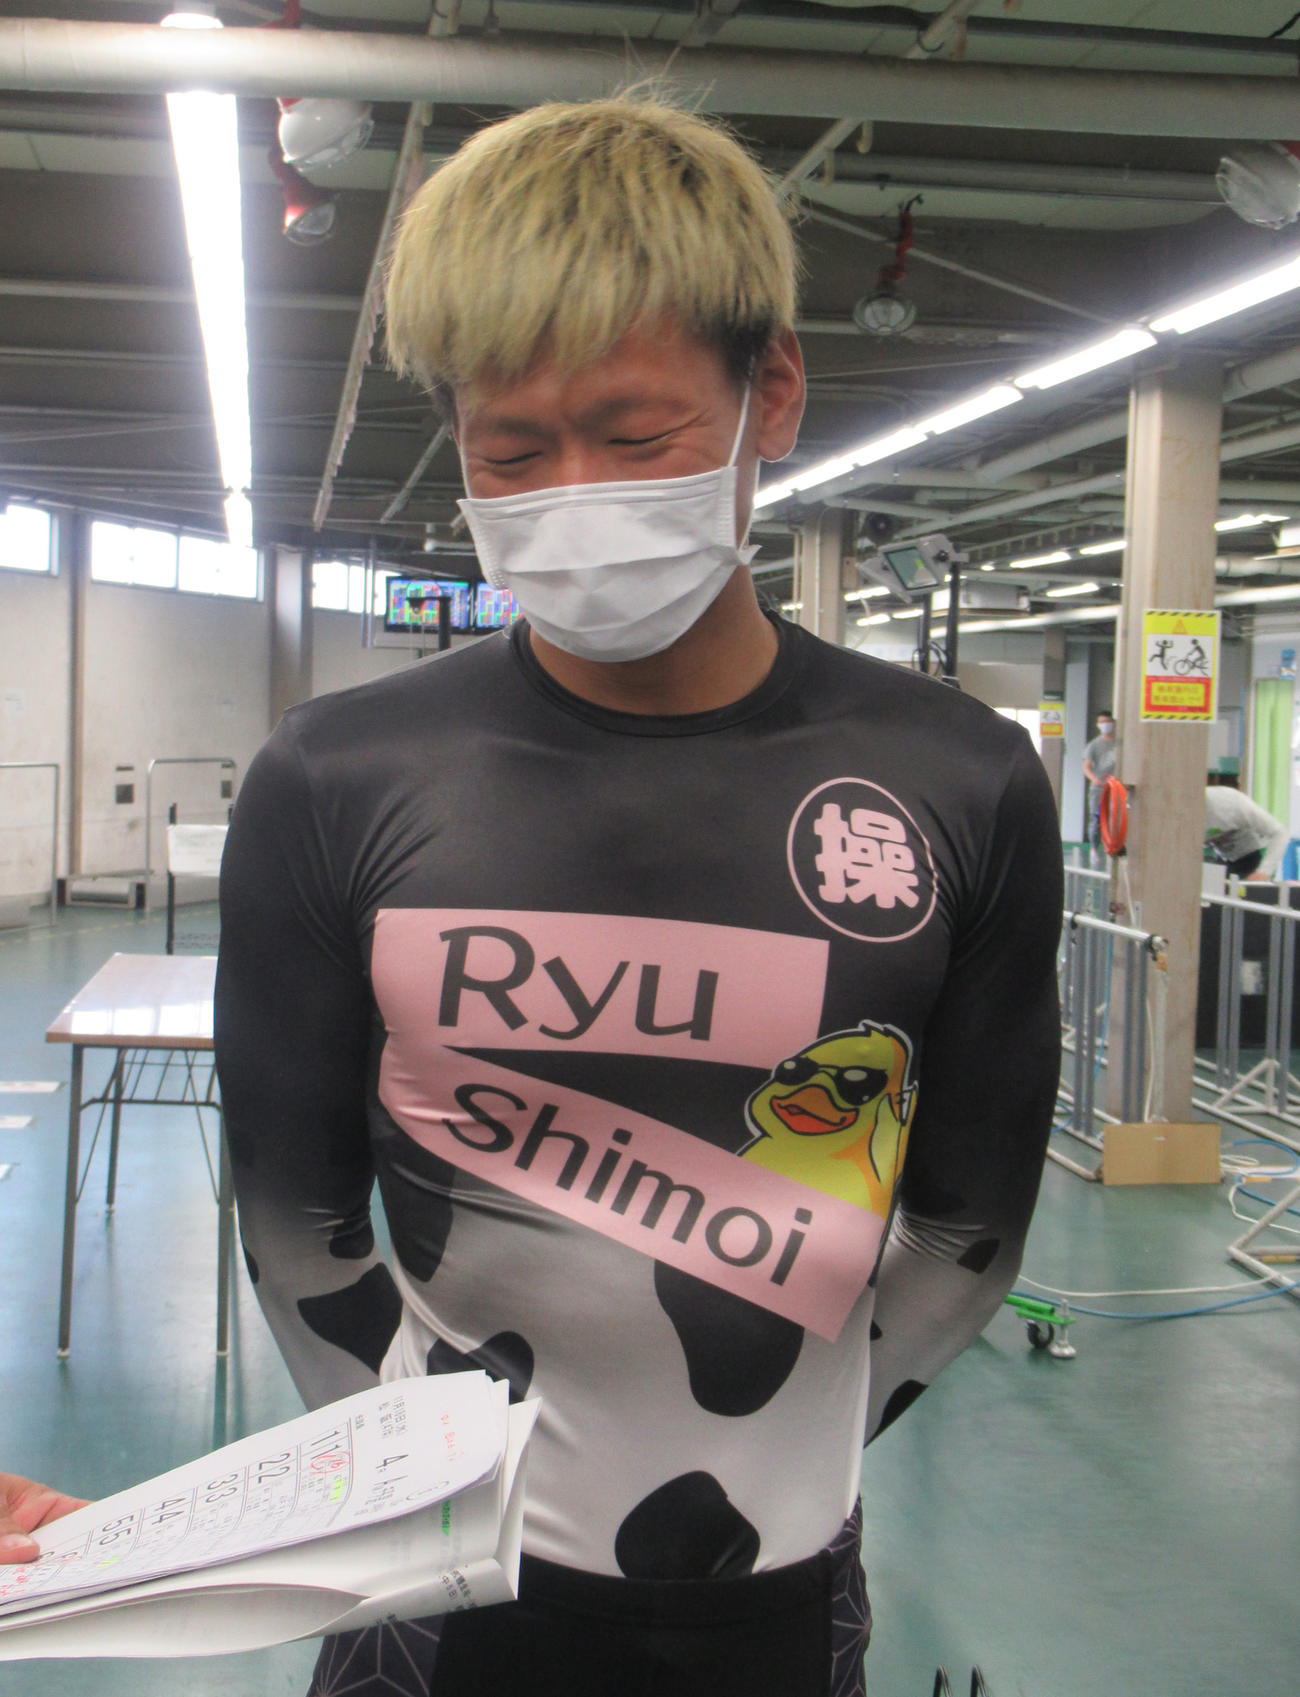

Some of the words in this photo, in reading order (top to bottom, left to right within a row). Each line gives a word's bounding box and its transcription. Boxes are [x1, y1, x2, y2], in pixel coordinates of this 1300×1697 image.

[813, 802, 919, 909] 操
[438, 925, 720, 1041] Ryu
[441, 1083, 813, 1287] Shimoi
